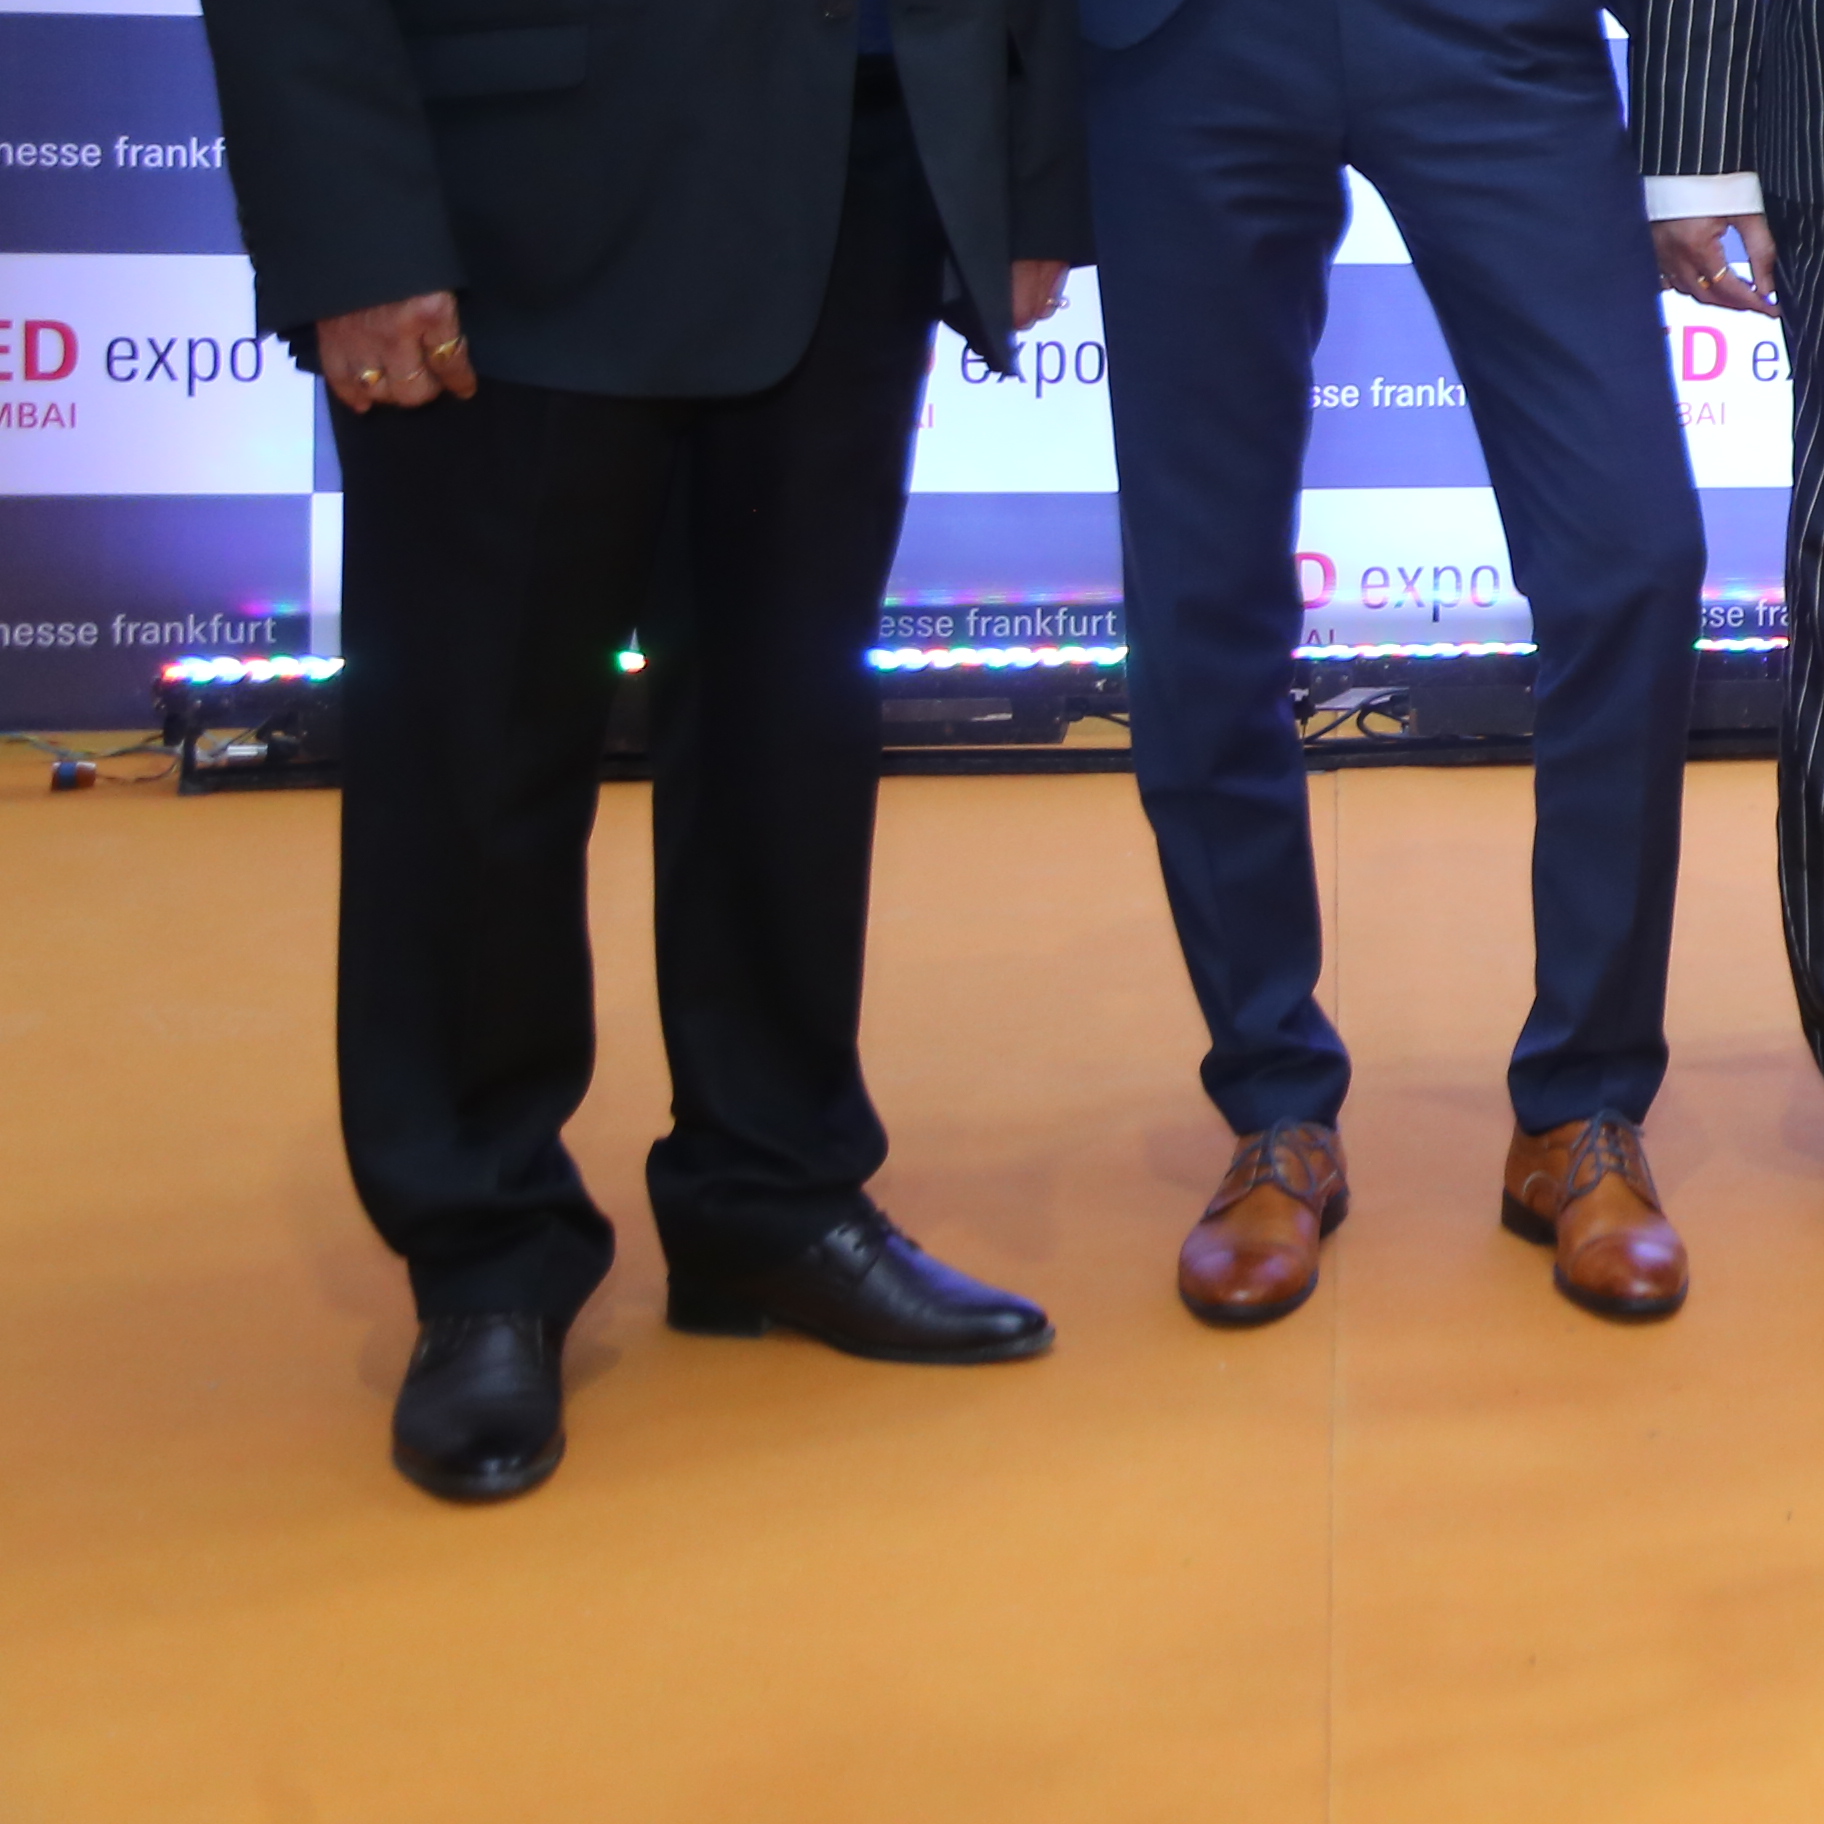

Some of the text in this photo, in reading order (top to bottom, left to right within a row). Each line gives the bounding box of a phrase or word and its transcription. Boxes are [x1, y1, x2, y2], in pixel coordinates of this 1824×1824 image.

[115, 135, 227, 169] frankf
[105, 336, 264, 398] expo
[1360, 564, 1501, 624] expo
[112, 613, 276, 645] frankfurt
[881, 607, 1118, 638] esse frankfurt
